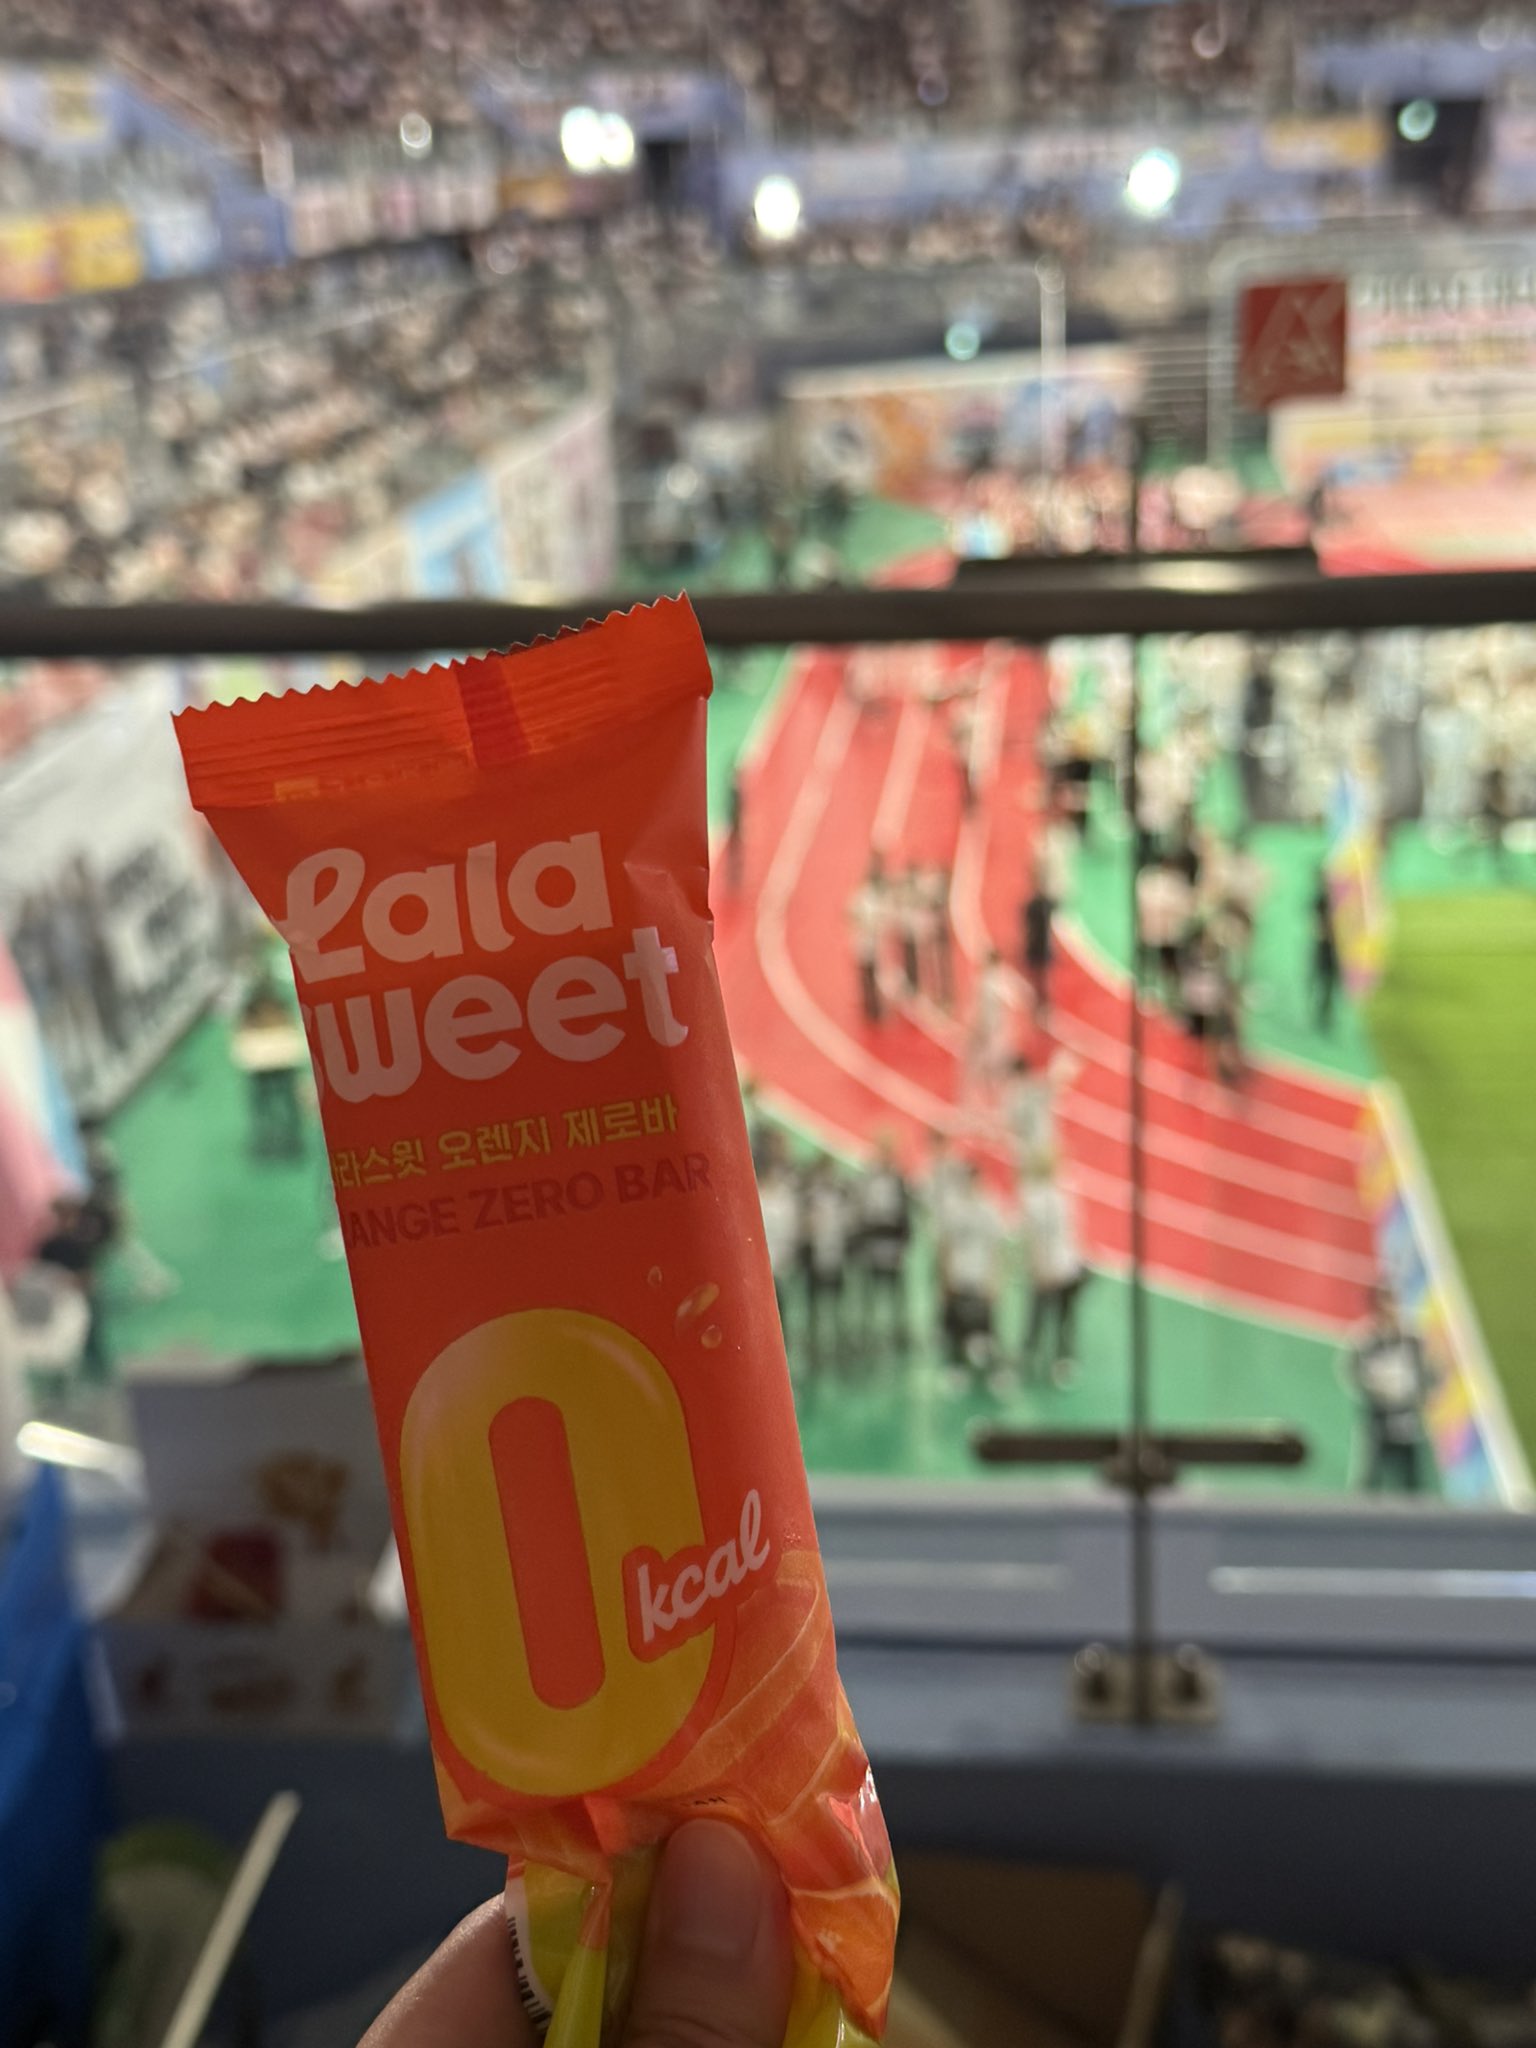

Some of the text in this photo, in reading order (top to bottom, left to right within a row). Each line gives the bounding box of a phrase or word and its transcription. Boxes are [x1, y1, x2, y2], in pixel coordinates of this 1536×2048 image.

[302, 926, 689, 1103] weet
[350, 1152, 713, 1249] ANGE ZERO BAR
[437, 1115, 550, 1171] 오렌지
[562, 1093, 678, 1148] 제로바
[400, 1308, 770, 1796] 0 kcal
